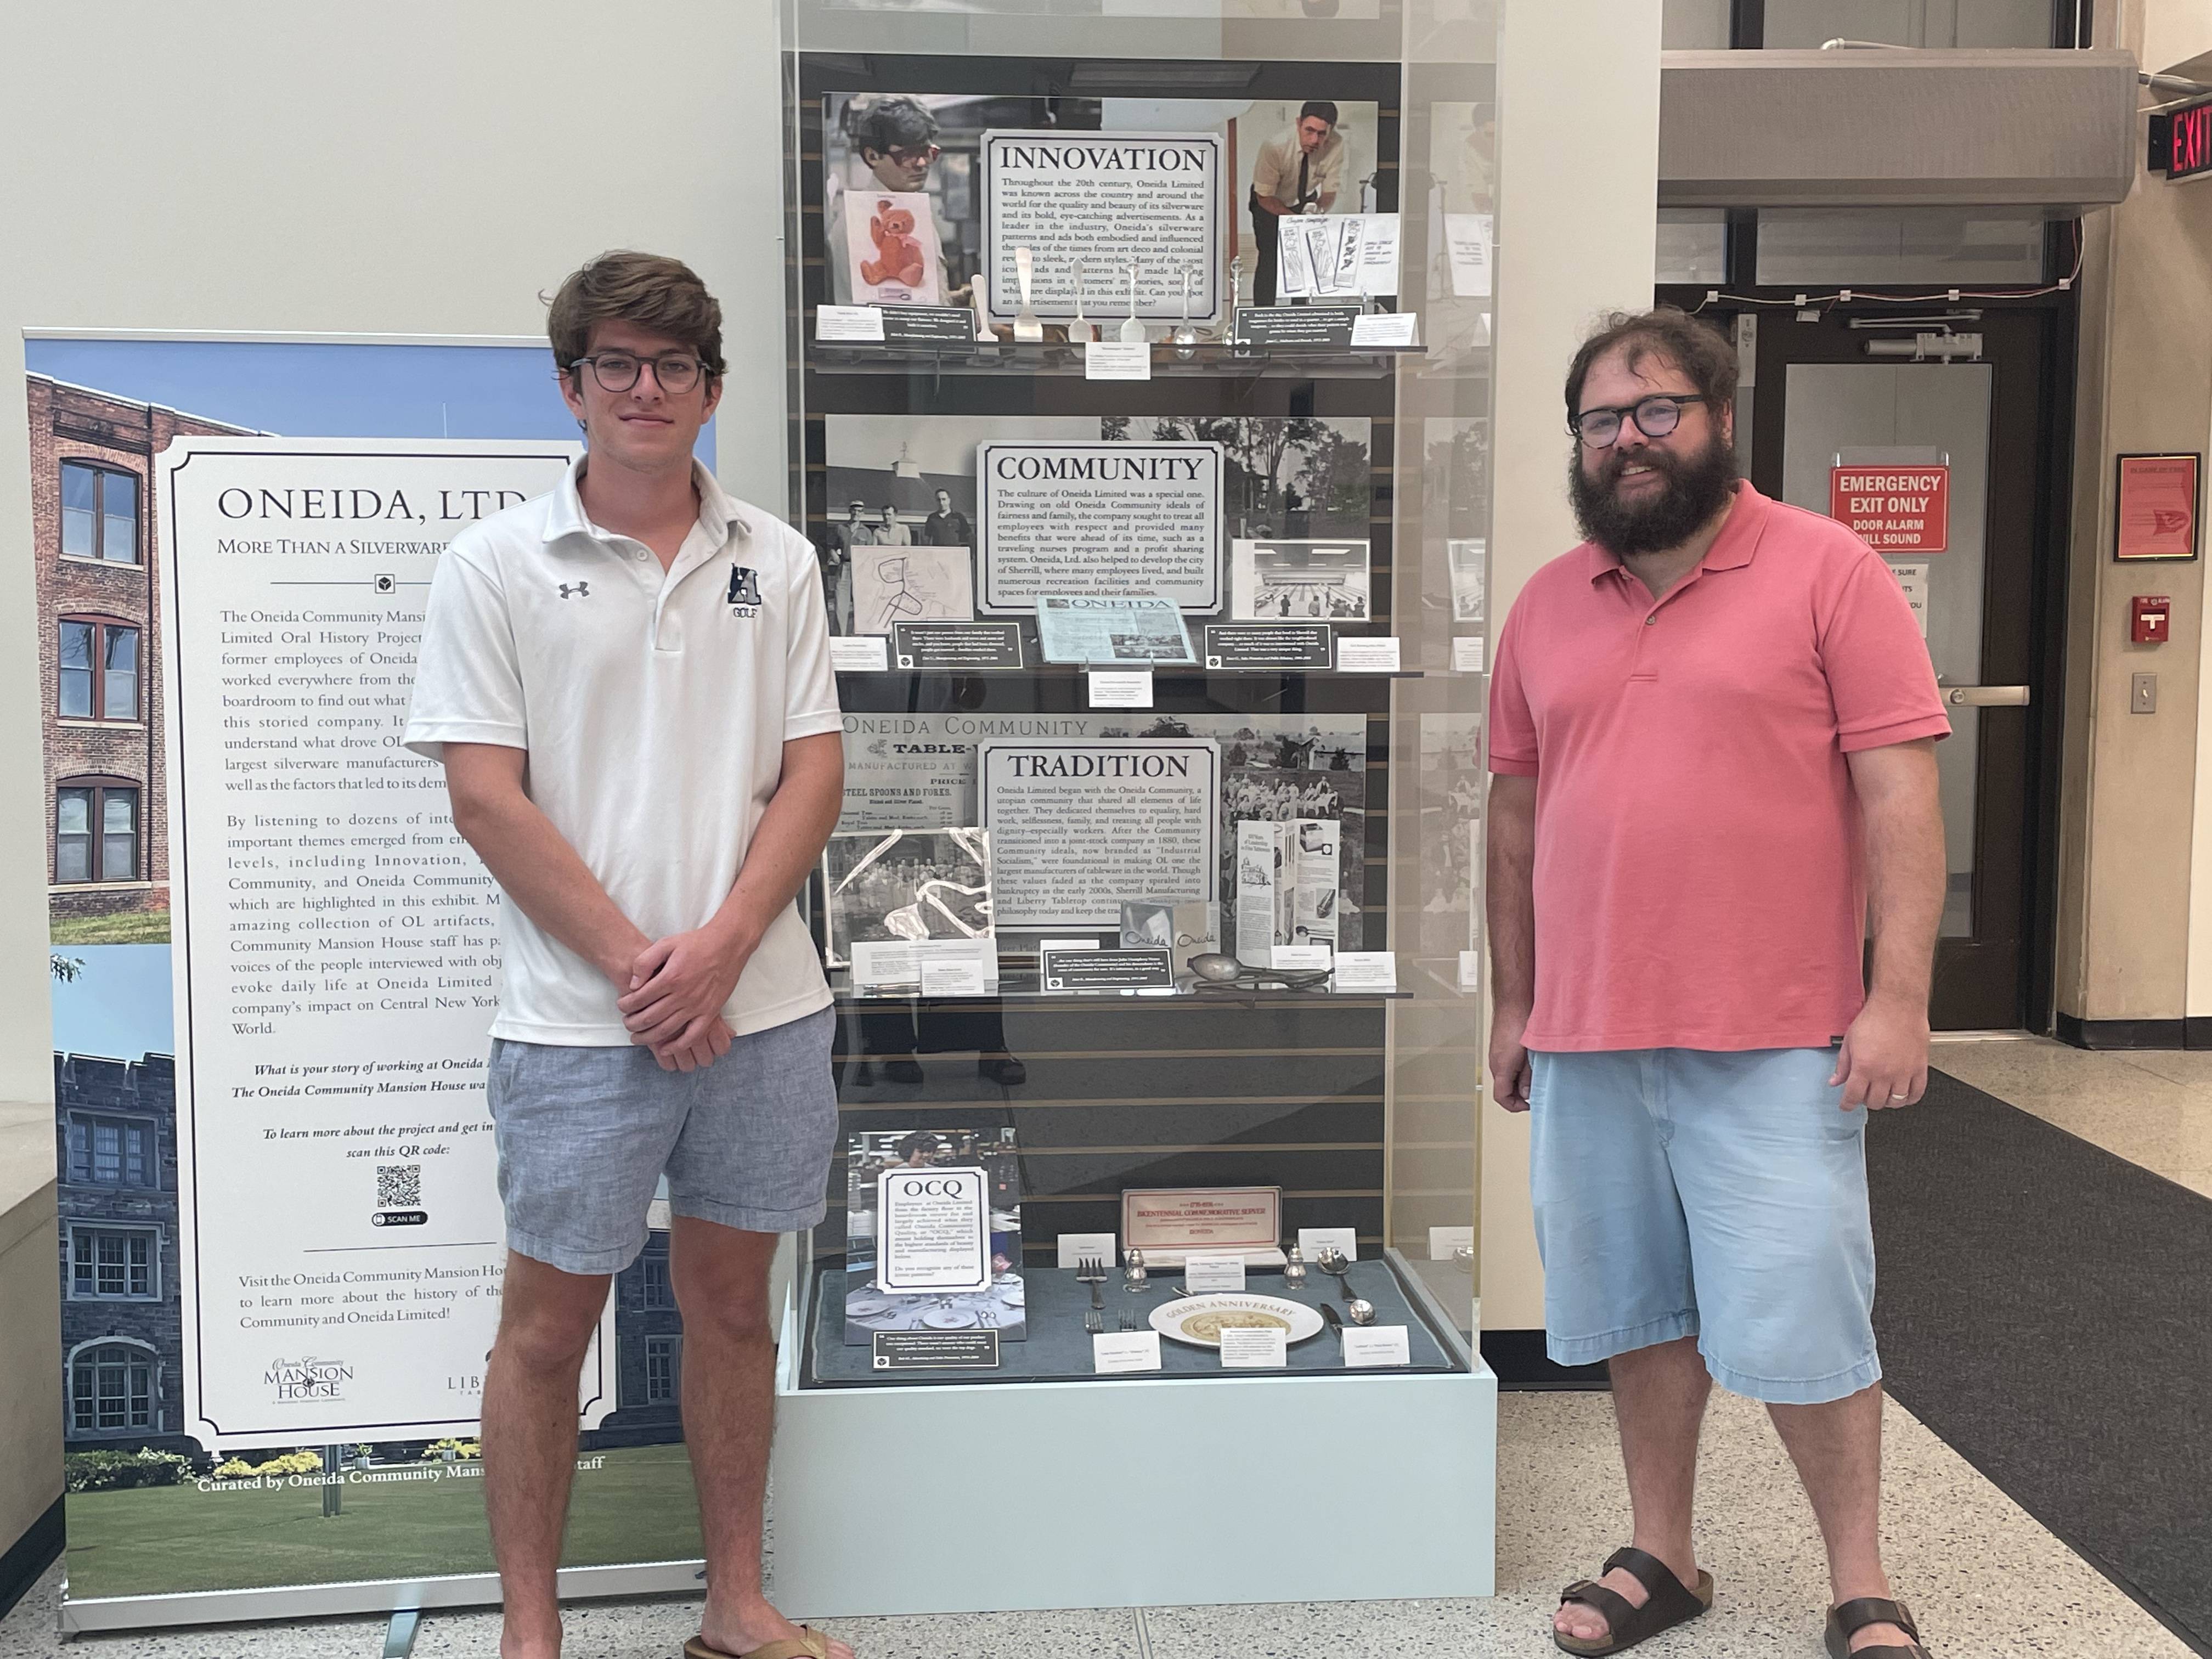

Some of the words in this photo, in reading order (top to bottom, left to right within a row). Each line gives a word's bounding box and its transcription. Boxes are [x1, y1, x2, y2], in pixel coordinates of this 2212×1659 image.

[2173, 105, 2212, 172] EXIT
[1000, 146, 1206, 171] INNOVATION
[1001, 178, 1053, 188] Throughout
[1136, 179, 1167, 188] Oneida
[1171, 180, 1204, 188] Limited
[1021, 189, 1050, 197] known
[1156, 191, 1187, 199] around
[997, 457, 1204, 480] COMMUNITY
[1840, 476, 1941, 492] EMERGENCY
[1061, 489, 1092, 498] Oneida
[1155, 490, 1184, 500] special
[218, 488, 425, 525] ONEIDA,
[1850, 497, 1885, 514] EXIT
[1888, 497, 1929, 513] ONLY
[1853, 520, 1883, 531] DOOR
[1885, 520, 1924, 531] ALARM
[218, 539, 272, 553] MORE
[276, 539, 330, 553] THAN
[335, 542, 346, 554] A
[1883, 533, 1921, 544] SOUND
[1072, 599, 1171, 608] ONEIDA
[219, 610, 246, 622] The
[251, 610, 299, 622] Oneida
[302, 611, 382, 625] Community
[733, 607, 758, 618] GOLF
[221, 631, 272, 643] Limited
[281, 631, 311, 643] Oral
[320, 631, 369, 646] History
[377, 631, 421, 646] Project
[222, 652, 267, 664] former
[274, 652, 342, 668] employees
[349, 652, 365, 664] of
[370, 652, 417, 664] Oneida
[222, 673, 270, 685] worked
[278, 673, 352, 689] everywhere
[359, 673, 391, 685] from
[398, 673, 415, 685] the
[843, 716, 930, 735] ONEIDA
[945, 716, 1088, 735] COMMUNITY
[1007, 754, 1189, 777] TRADITION
[1059, 786, 1081, 795] began
[1148, 786, 1194, 795] Community,
[228, 856, 278, 868] levels,
[289, 855, 365, 869] including
[375, 855, 466, 866] Innovation,
[229, 878, 315, 891] Community,
[324, 876, 347, 887] and
[357, 874, 405, 887] Oneida
[413, 873, 494, 888] Community
[229, 898, 268, 910] which
[303, 895, 375, 911] highlighted
[402, 895, 425, 906] this
[432, 894, 478, 906] exhibit.
[232, 1001, 301, 1017] company's
[308, 1002, 351, 1014] impact
[380, 997, 427, 1009] Central
[435, 997, 466, 1008] New
[471, 995, 499, 1007] York
[232, 1022, 275, 1034] World.
[263, 1128, 276, 1139] To
[280, 1128, 308, 1138] learn
[343, 1126, 374, 1136] about
[378, 1125, 395, 1135] the
[398, 1124, 435, 1137] project
[438, 1122, 459, 1132] and
[460, 1124, 478, 1135] get
[482, 1121, 493, 1131] in
[374, 1146, 394, 1156] this
[399, 1145, 419, 1158] QR
[423, 1144, 449, 1154] code:
[904, 1180, 963, 1200] OCQ
[239, 1276, 268, 1286] Visit
[271, 1274, 290, 1285] the
[294, 1272, 340, 1284] Oneida
[343, 1271, 421, 1282] Community
[424, 1267, 479, 1279] Mansion
[1167, 1303, 1206, 1318] GOLDEN
[1210, 1300, 1296, 1317] ANNIVERSARY
[240, 1317, 319, 1328] Community
[322, 1312, 345, 1324] and
[347, 1310, 394, 1323] Oneida
[397, 1307, 449, 1321] Limited!
[264, 1366, 353, 1385] MANSION
[278, 1383, 340, 1399] HOUSE
[198, 1476, 262, 1492] Curated
[266, 1476, 284, 1491] by
[289, 1472, 345, 1487] Oneida
[349, 1467, 443, 1483] Community
[577, 1455, 606, 1470] taff
